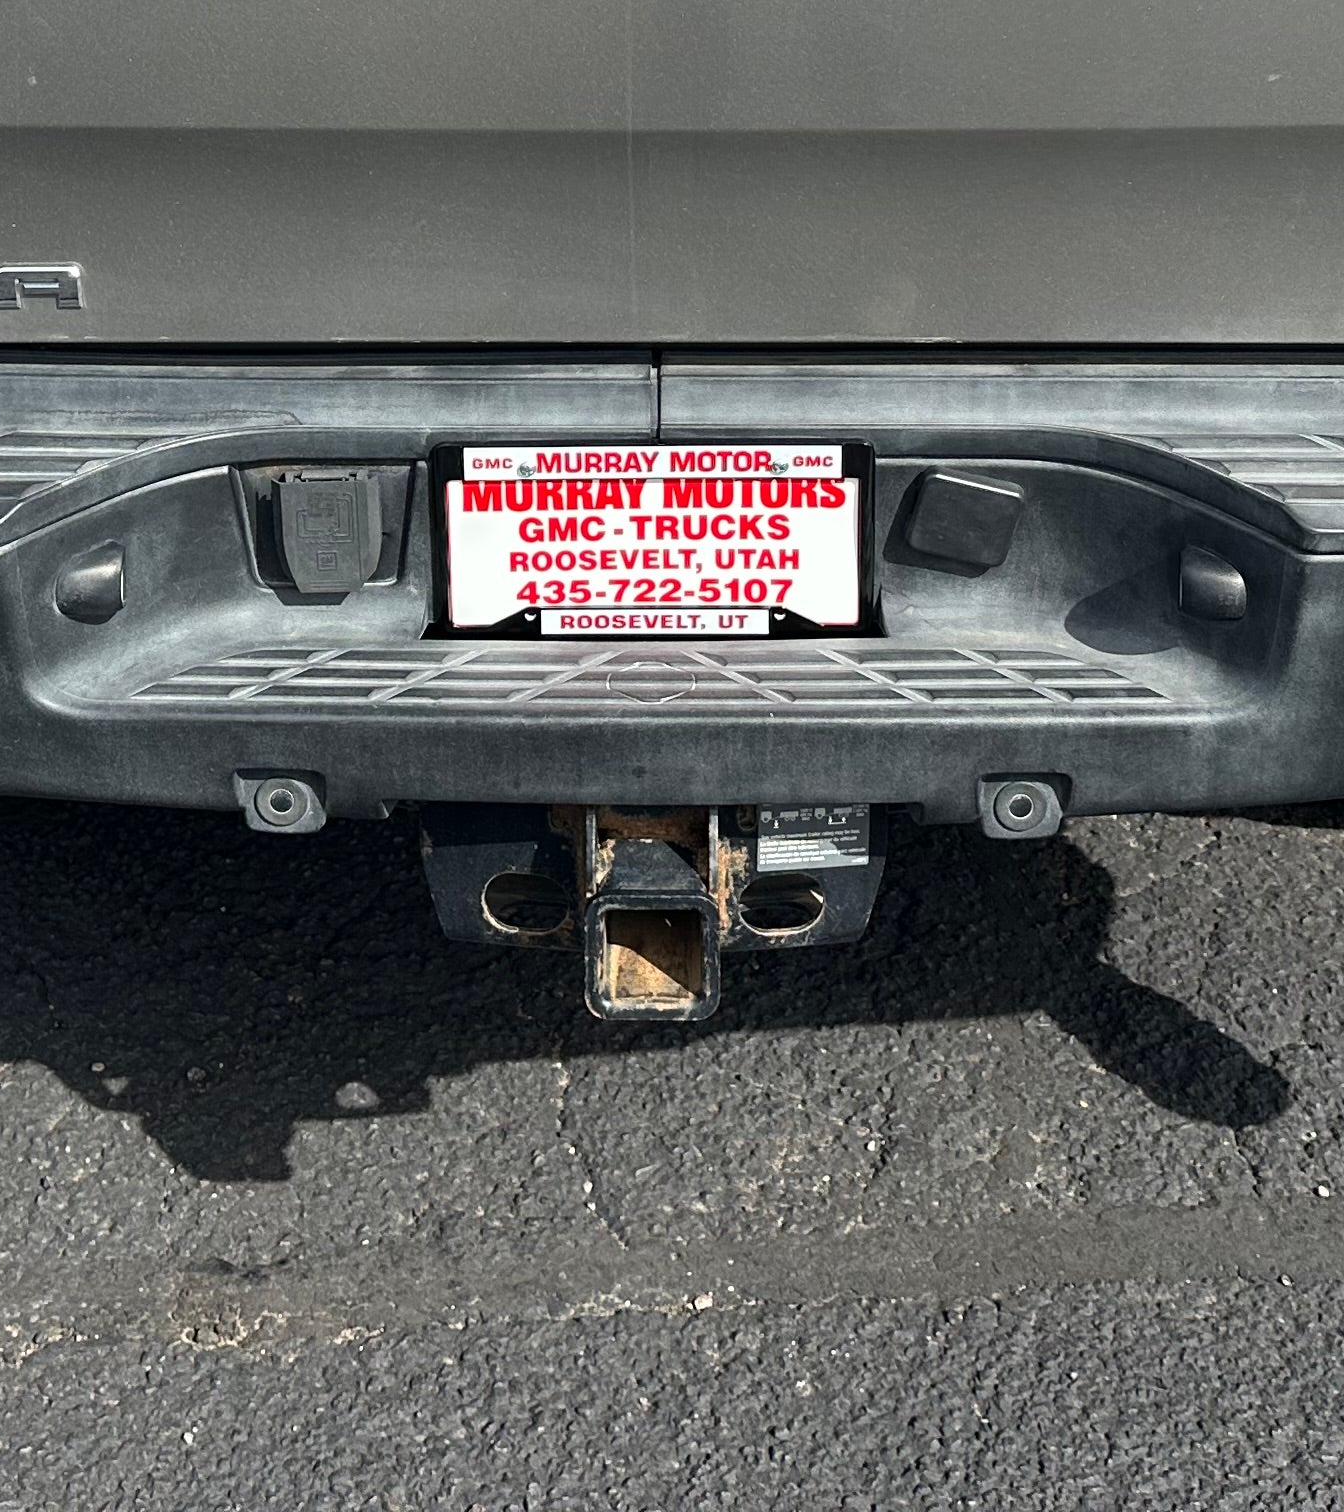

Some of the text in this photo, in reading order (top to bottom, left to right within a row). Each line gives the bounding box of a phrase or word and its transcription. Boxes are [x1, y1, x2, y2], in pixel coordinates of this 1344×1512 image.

[472, 450, 834, 474] GMC MURRAY MOTOR GMC
[462, 478, 847, 513] MURRAY MOTORS
[518, 515, 606, 543] GMC
[628, 514, 790, 541] TRUCKS
[509, 548, 800, 574] ROOSEVELT, UTAH
[516, 578, 794, 605] 435-722-5107
[560, 614, 749, 631] ROOSEVELT, UT
